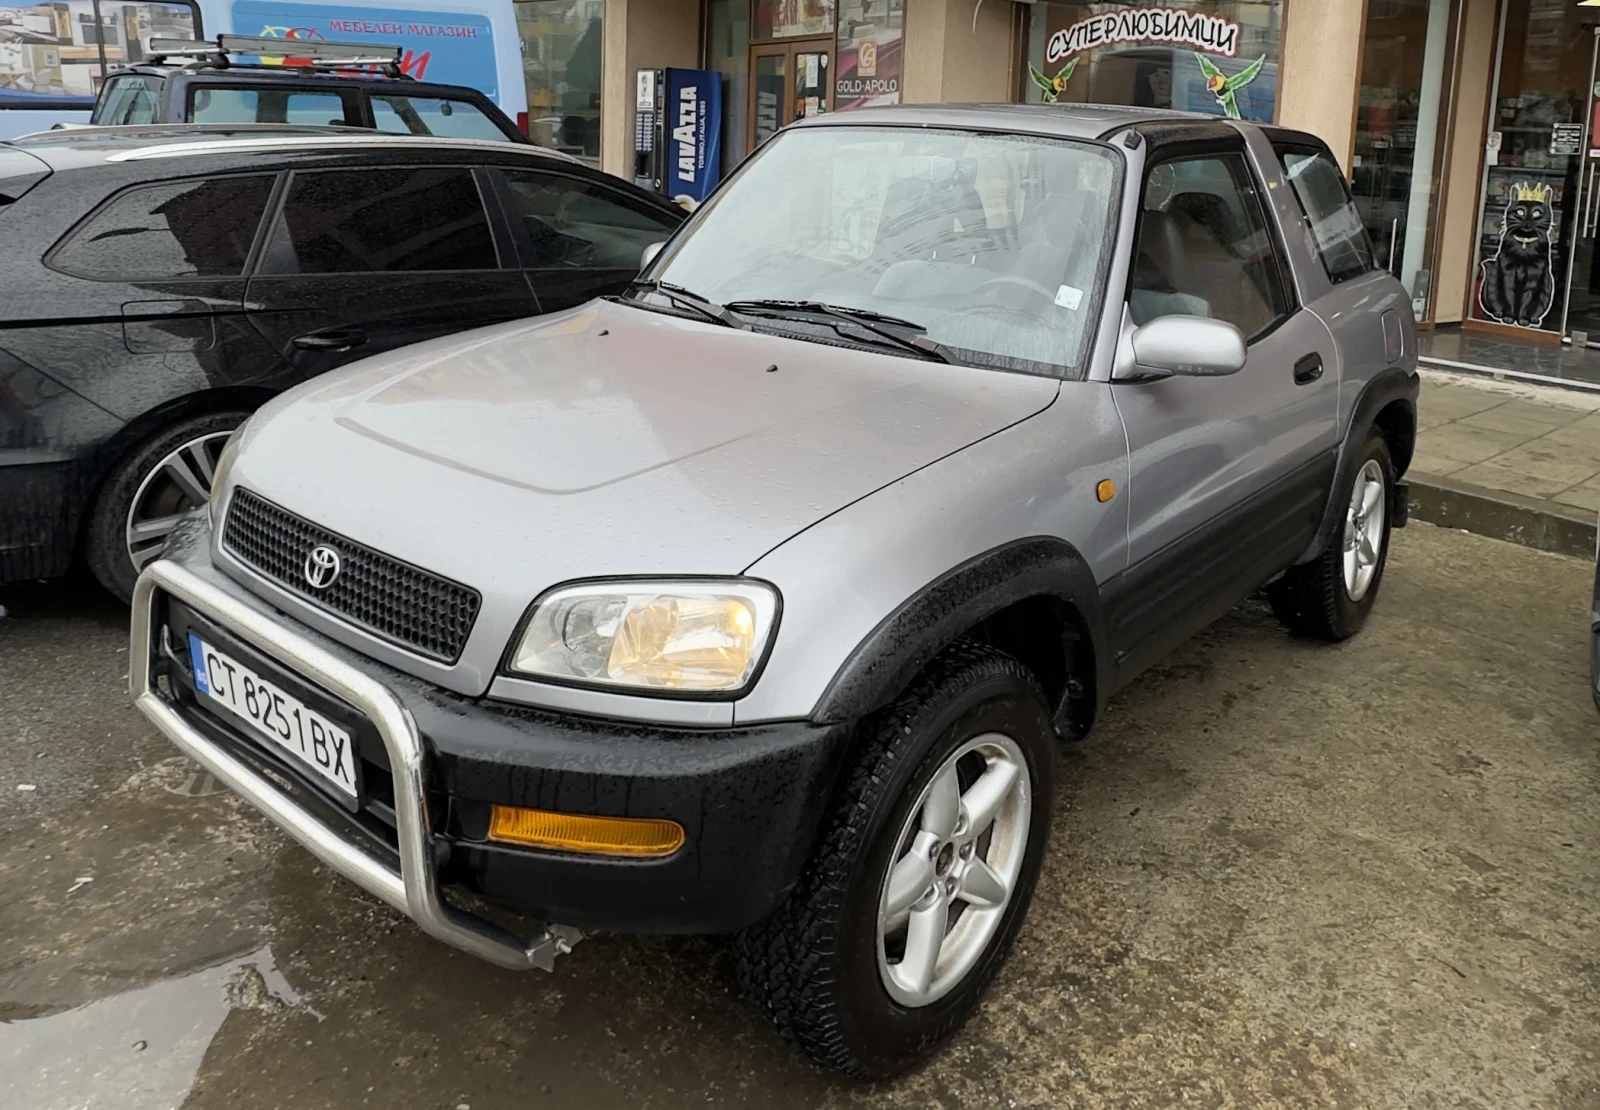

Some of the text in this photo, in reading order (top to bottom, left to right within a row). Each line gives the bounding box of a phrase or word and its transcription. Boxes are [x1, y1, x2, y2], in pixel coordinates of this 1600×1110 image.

[329, 20, 477, 38] МЕБЕЛЕН МАГАЗИН
[1048, 11, 1236, 60] СУПЕРЛЮБИМЦИ
[673, 86, 697, 182] LAVAZZA
[243, 675, 305, 753] 8251
